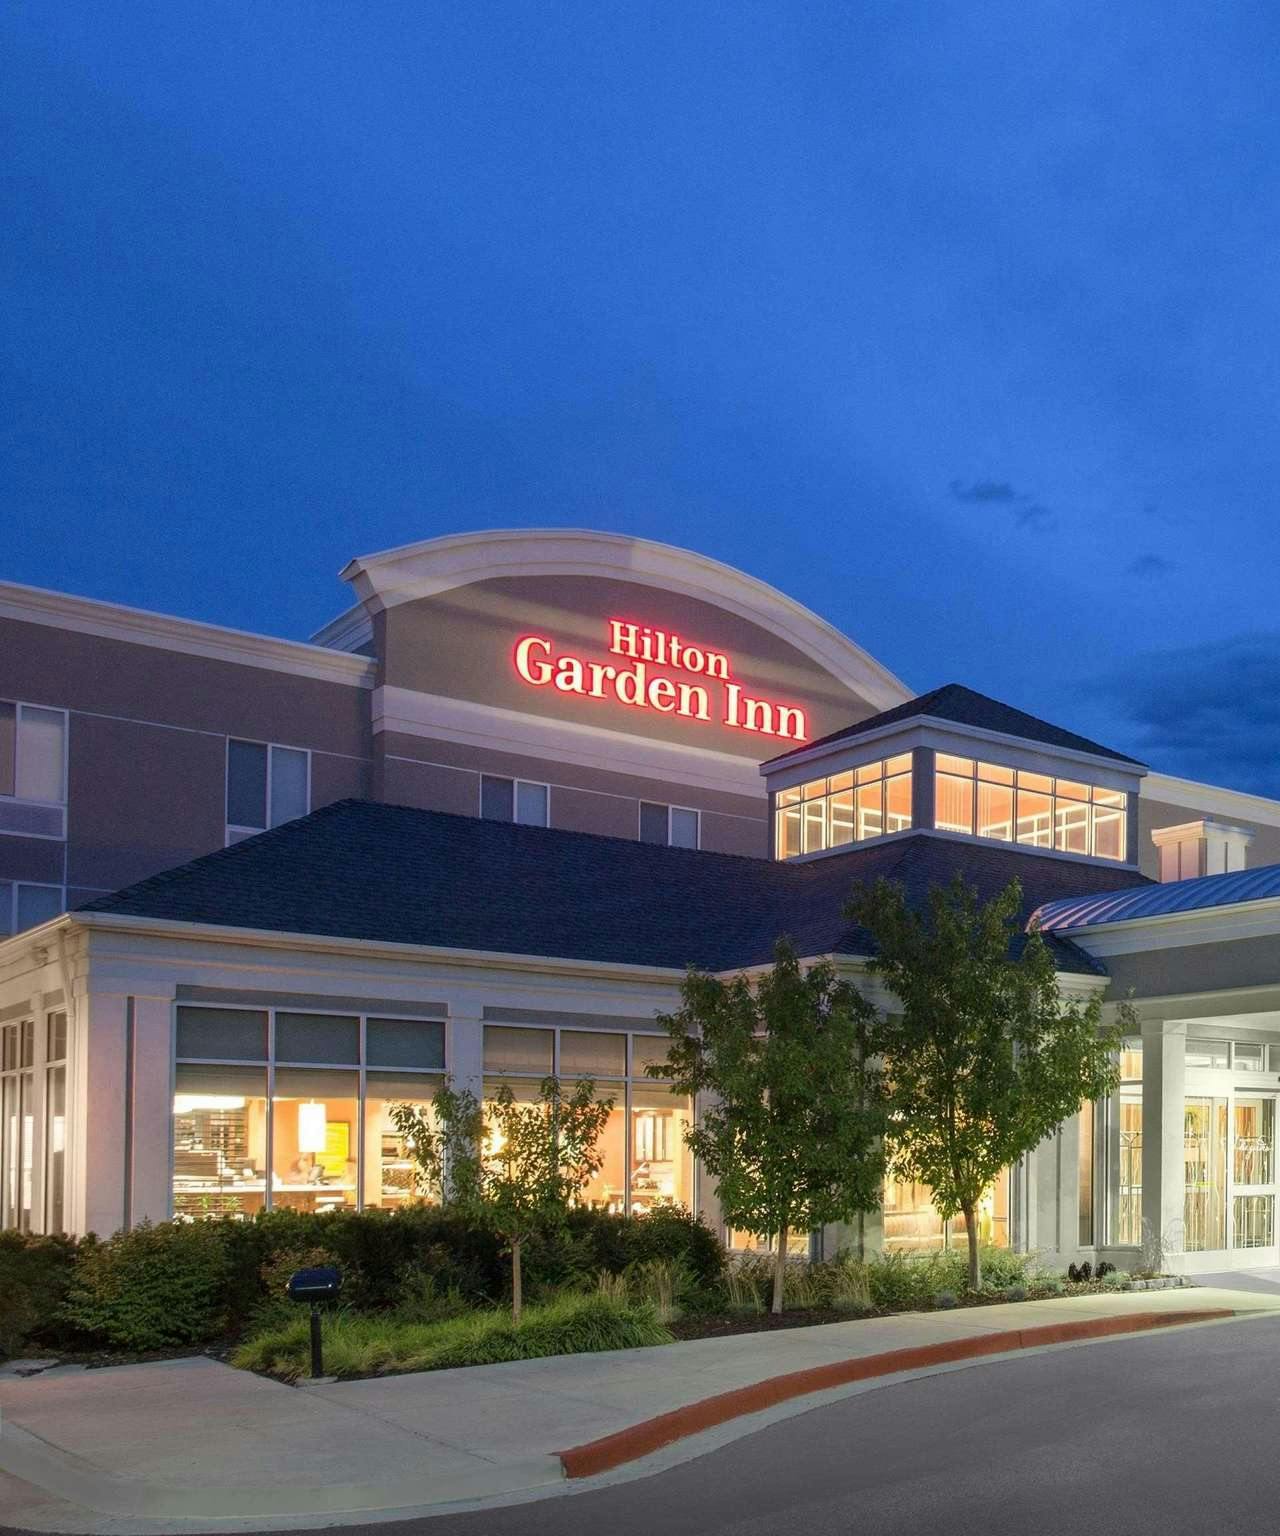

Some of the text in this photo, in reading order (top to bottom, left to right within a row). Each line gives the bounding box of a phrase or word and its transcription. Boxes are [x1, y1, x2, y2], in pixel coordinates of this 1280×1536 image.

[516, 637, 807, 741] Garden Inn
[609, 620, 731, 680] Hilton
